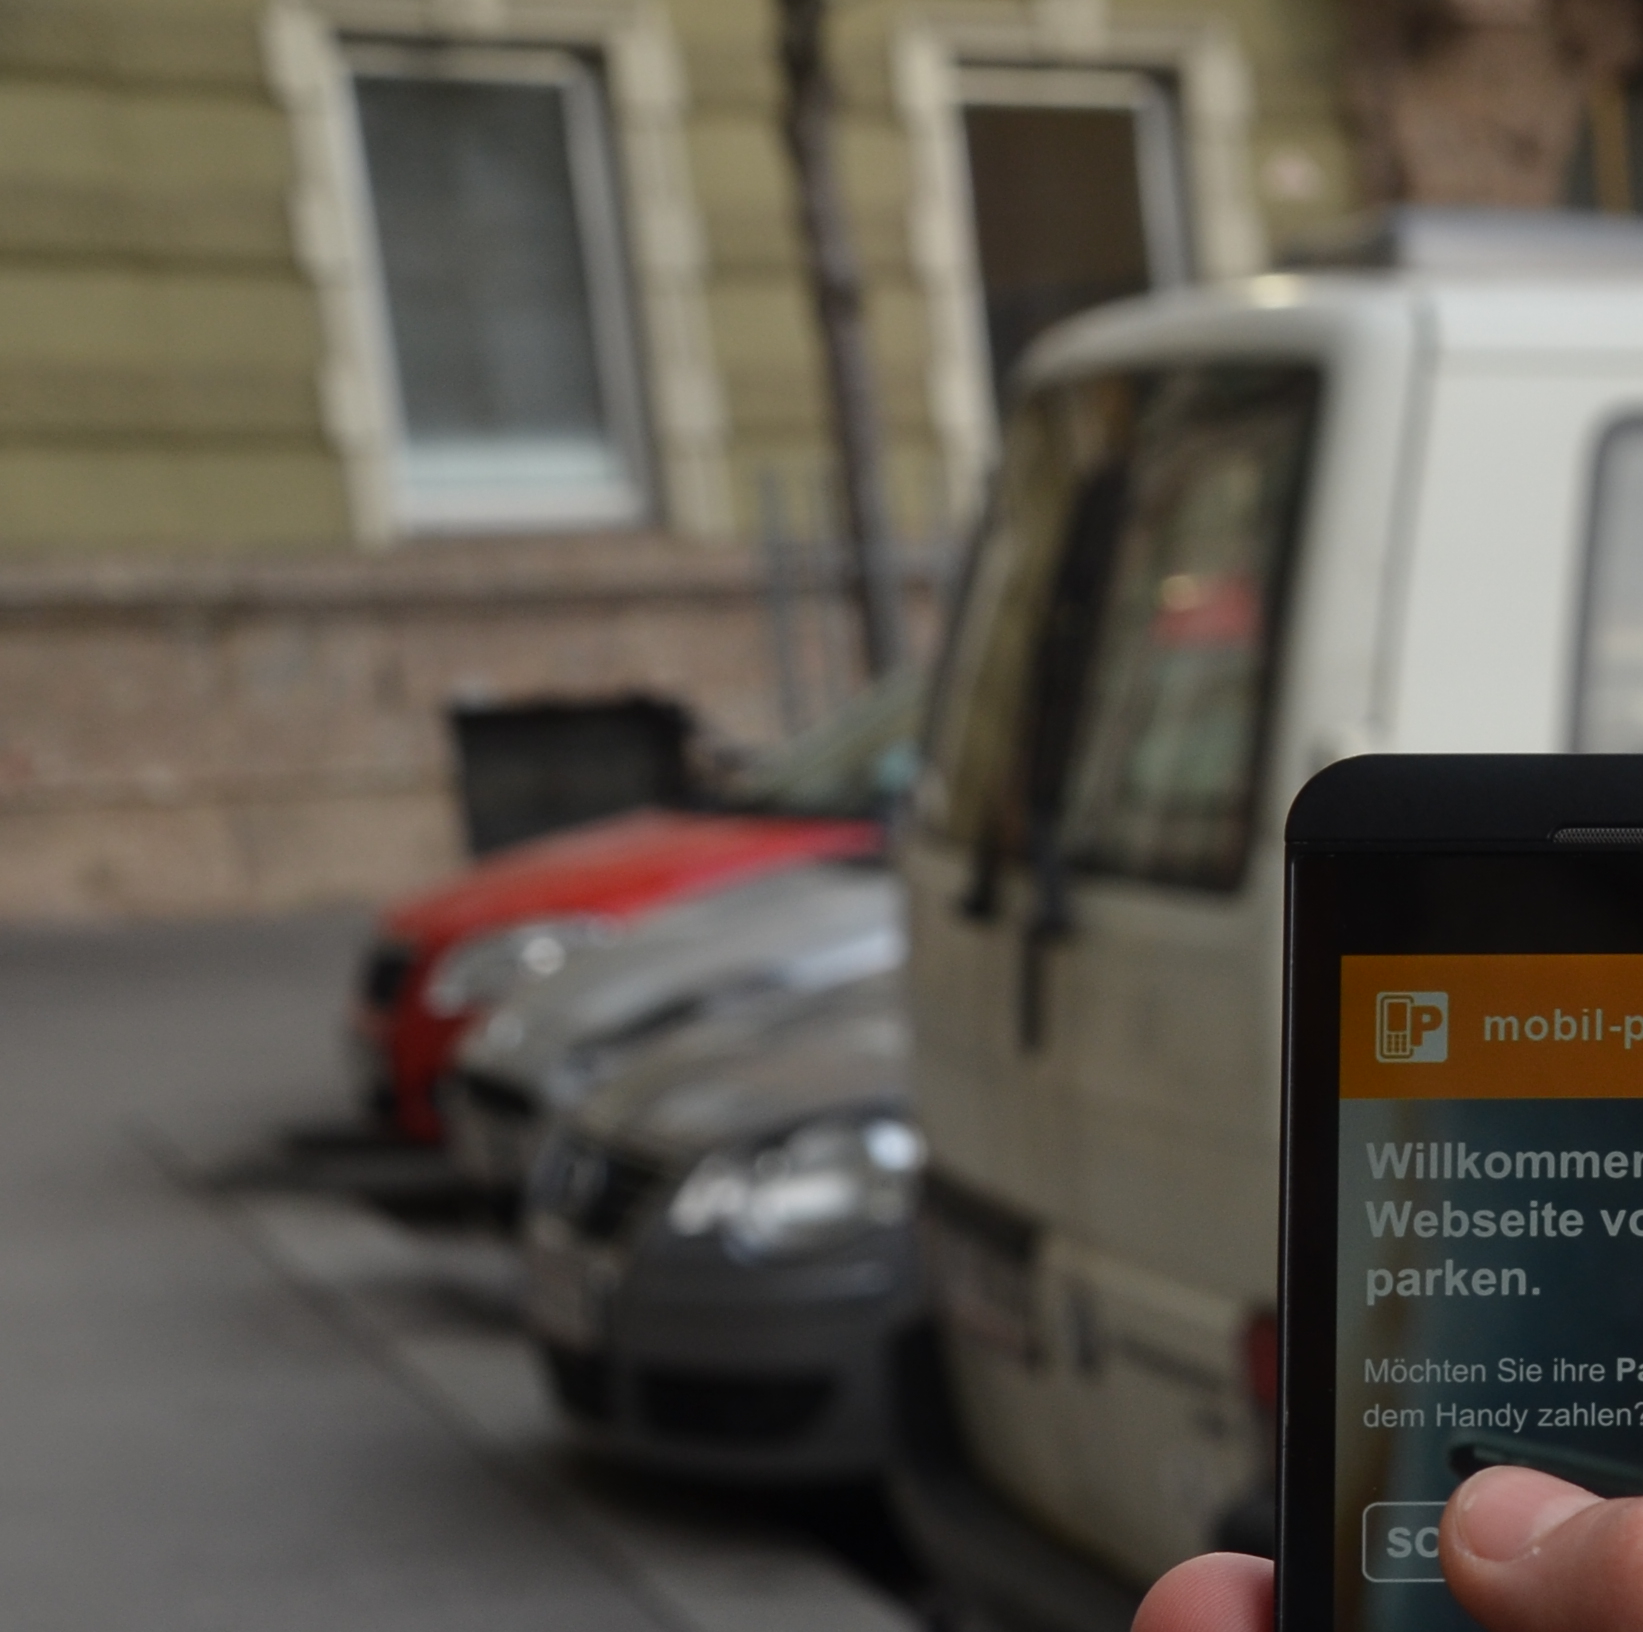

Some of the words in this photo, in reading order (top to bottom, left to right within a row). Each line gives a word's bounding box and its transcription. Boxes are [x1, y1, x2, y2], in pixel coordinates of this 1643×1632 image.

[1365, 1201, 1584, 1238] Webseite
[1366, 1259, 1542, 1306] parken.
[1364, 1356, 1487, 1384] Möchten
[1497, 1356, 1543, 1384] Sie
[1553, 1357, 1606, 1383] ihre
[1363, 1402, 1426, 1428] dem
[1435, 1402, 1528, 1434] Handy
